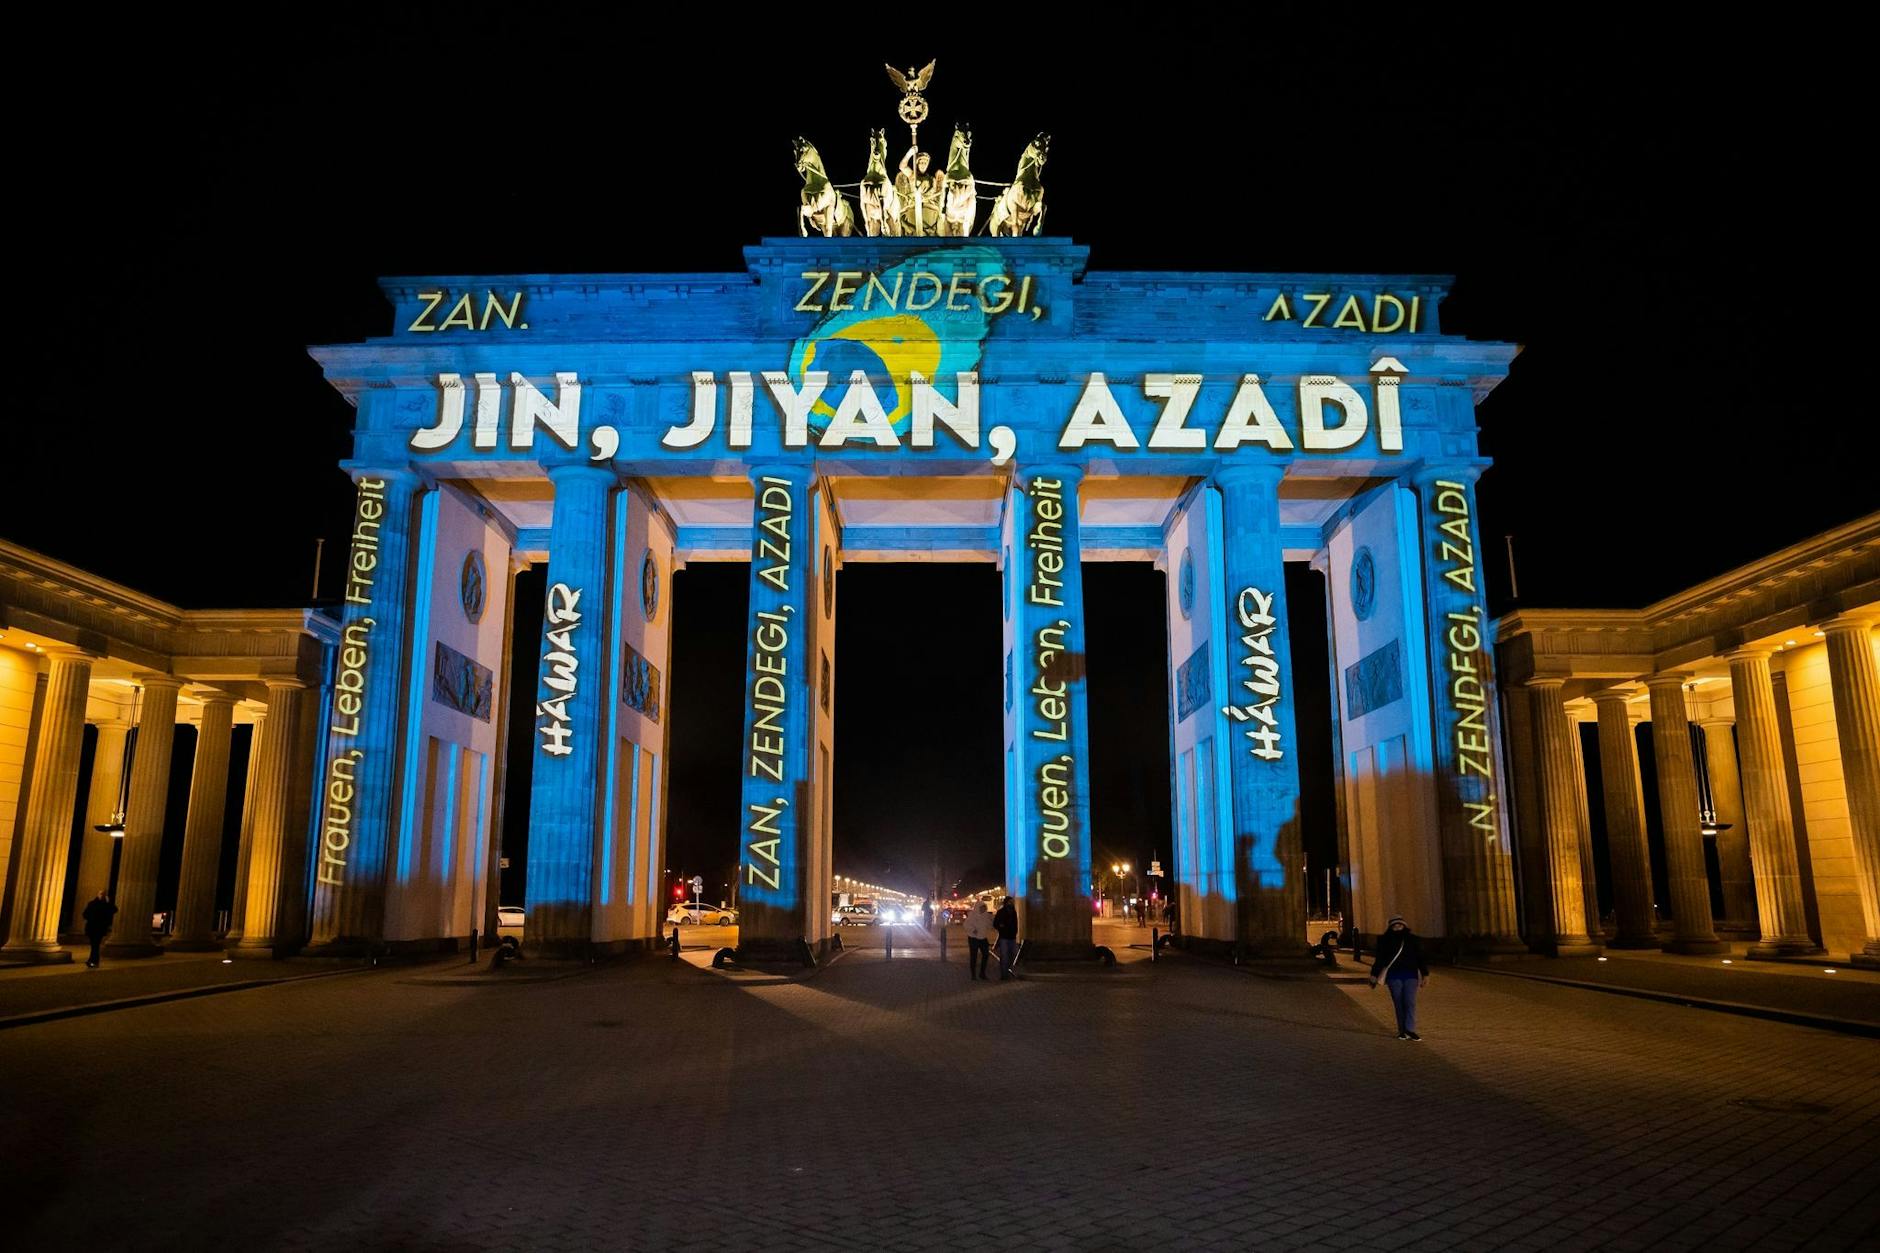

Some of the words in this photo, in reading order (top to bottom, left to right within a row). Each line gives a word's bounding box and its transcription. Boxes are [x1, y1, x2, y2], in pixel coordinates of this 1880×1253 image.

[793, 272, 1042, 321] ZENDEGI,
[410, 372, 620, 461] JIN,
[662, 370, 1017, 466] JIYAN,
[1058, 356, 1411, 451] AZADÎ
[346, 476, 386, 605] Freiheit
[757, 476, 794, 592] AZADI
[1030, 476, 1065, 607] Freiheit
[1436, 479, 1477, 593] AZADI
[332, 616, 378, 737] Leben,
[752, 603, 796, 781] ZENDEGI,
[317, 748, 364, 887] Frauen,
[748, 796, 790, 891] ZAN,
[1036, 755, 1074, 890] auen,
